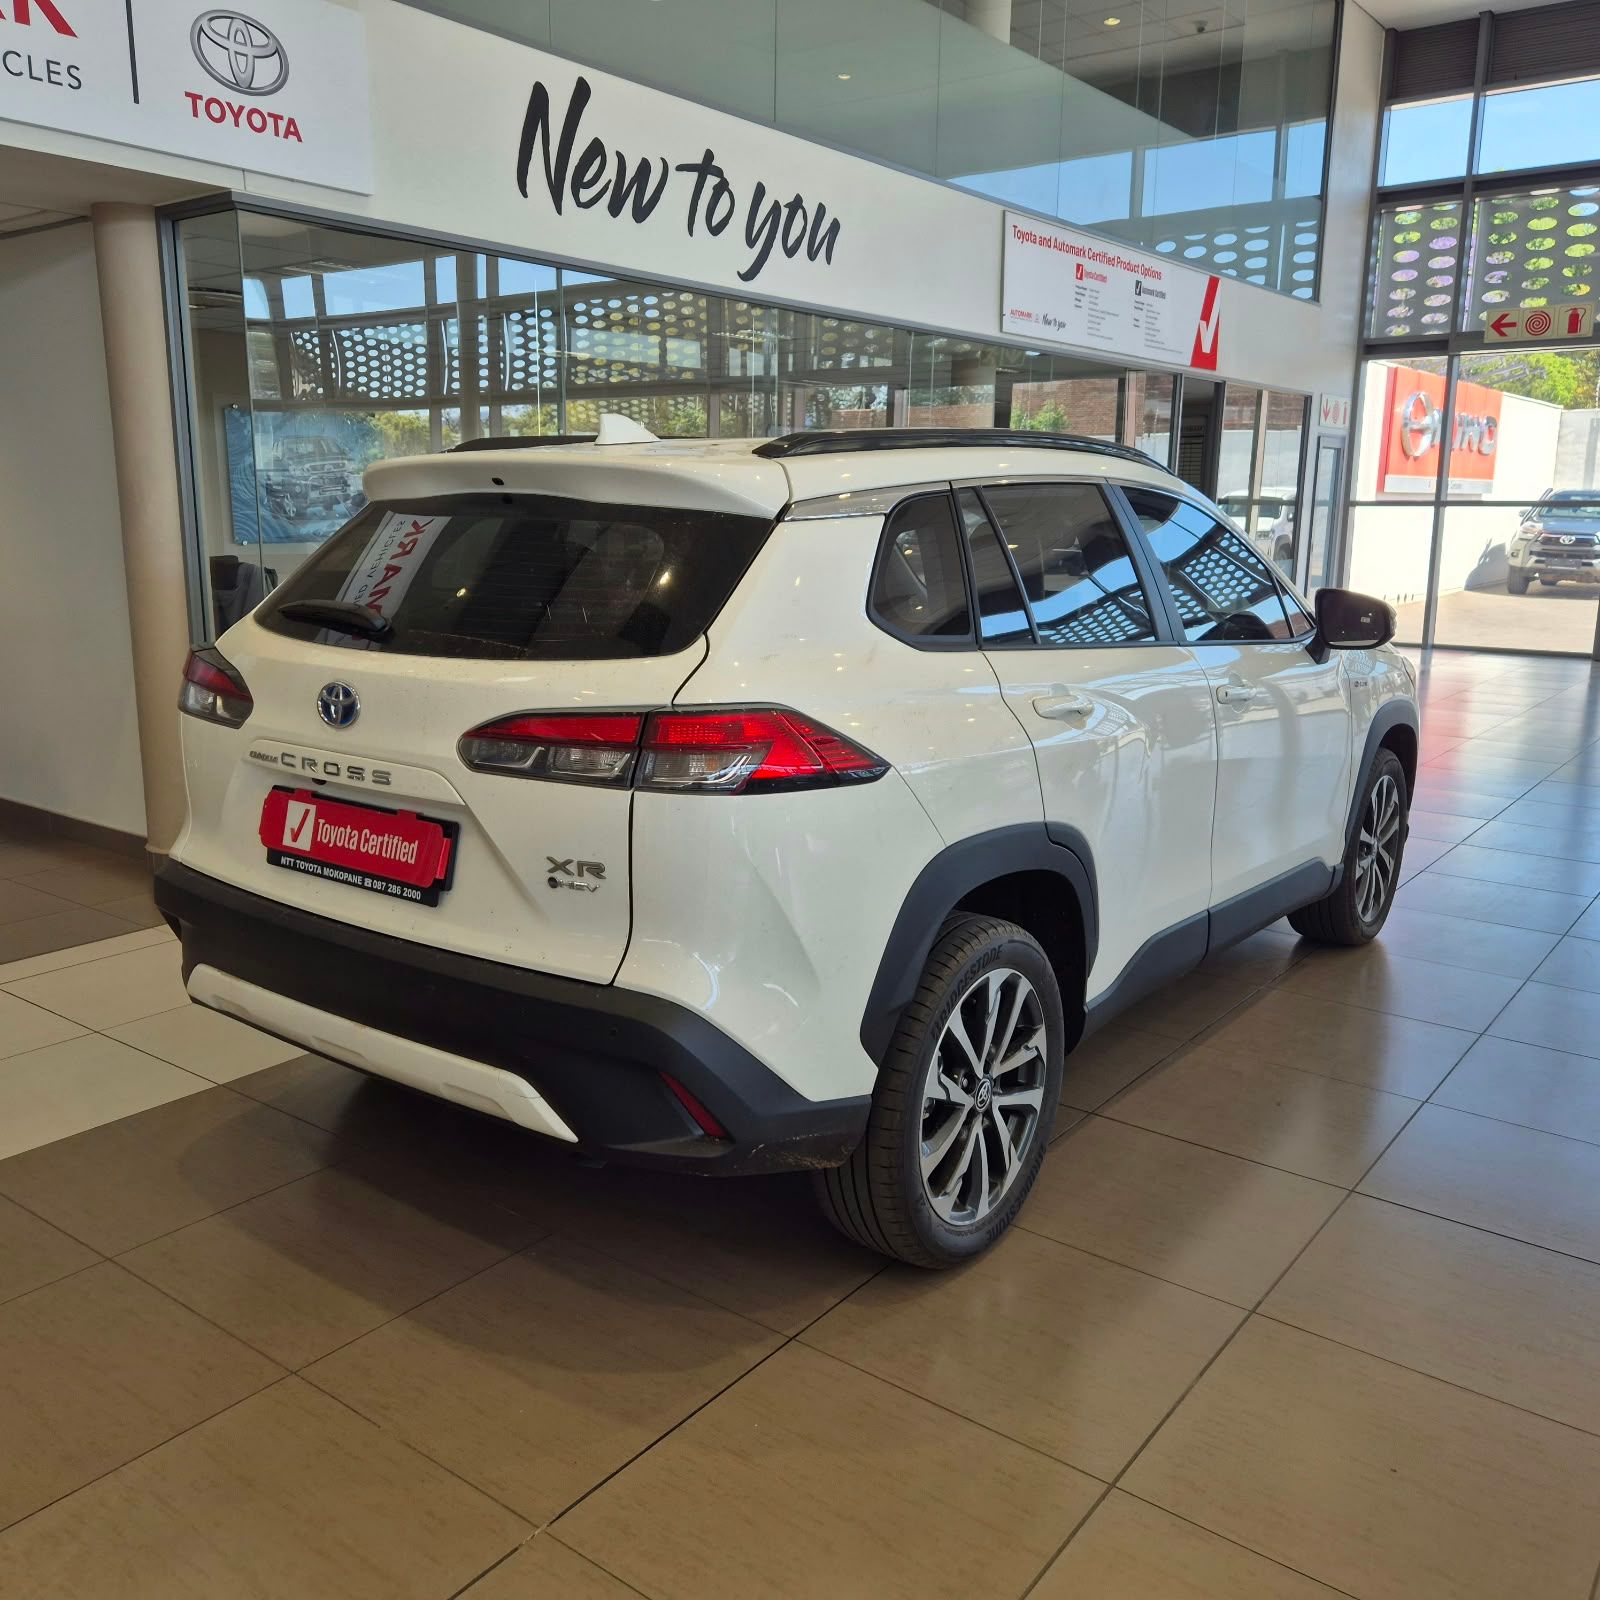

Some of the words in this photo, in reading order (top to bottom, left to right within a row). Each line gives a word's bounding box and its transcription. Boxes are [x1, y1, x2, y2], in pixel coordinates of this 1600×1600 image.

[184, 91, 304, 143] TOYOTA
[516, 75, 669, 224] New
[675, 148, 736, 238] to
[736, 181, 841, 282] you
[1012, 224, 1037, 245] Toyota
[1038, 235, 1052, 249] and
[1053, 236, 1087, 259] Automark
[1087, 247, 1116, 267] Certified
[1116, 255, 1140, 276] Product
[1140, 263, 1162, 281] Options
[281, 751, 392, 786] CROSS
[316, 818, 359, 851] Toyota
[359, 828, 419, 865] Certified
[280, 855, 295, 868] NTT
[295, 858, 323, 876] TOYOTA
[323, 866, 363, 886] MOKOPANE
[372, 881, 386, 892] 087
[387, 884, 401, 896] 286
[402, 888, 422, 901] 2000
[546, 856, 607, 880] XR
